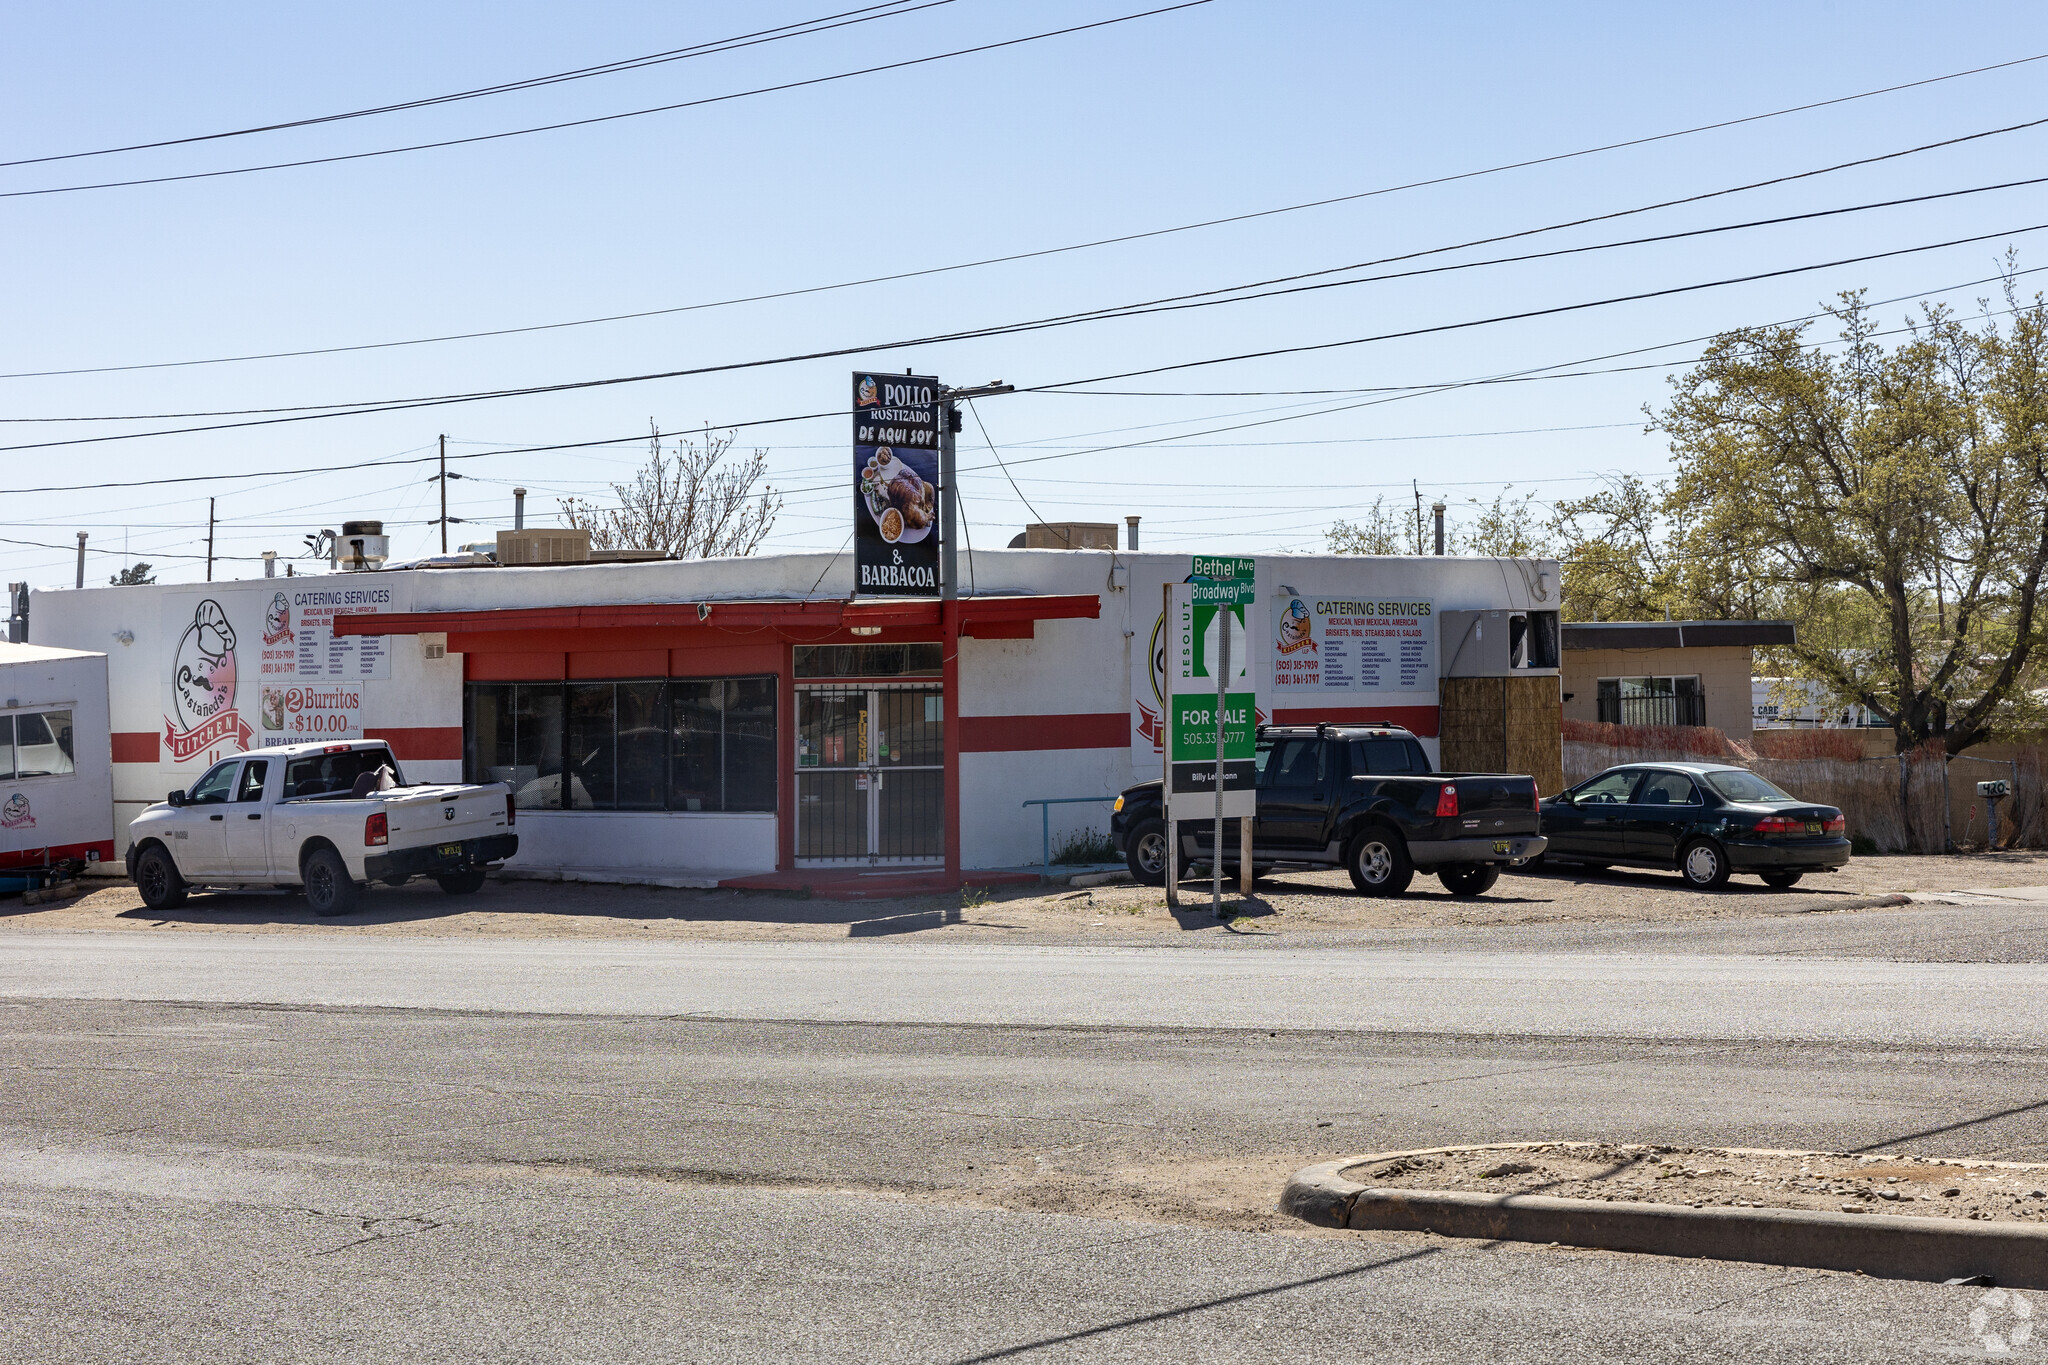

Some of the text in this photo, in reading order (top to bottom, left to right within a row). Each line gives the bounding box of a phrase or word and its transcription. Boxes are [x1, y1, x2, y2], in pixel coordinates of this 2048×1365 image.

[885, 384, 931, 408] POLLO
[871, 408, 930, 423] ROSTIZADO
[859, 426, 934, 445] DE AQUI SOY
[892, 549, 904, 565] &
[1194, 558, 1254, 576] Bethel Ave
[861, 564, 936, 587] BARBACOA
[295, 590, 390, 606] CATERING SERVICES
[1192, 582, 1254, 603] Broadway Blvd
[303, 608, 323, 616] MEXICAN,
[1316, 601, 1431, 616] CATERING SERVICES
[1328, 618, 1352, 626] MEXICAN,
[1325, 629, 1350, 637] BRISKETS,
[1351, 629, 1363, 637] RIBS,
[1276, 659, 1292, 671] (505)
[1275, 674, 1292, 686] (505)
[177, 665, 228, 716] Castañeda's
[288, 687, 359, 710] 2 Burritos
[1182, 710, 1210, 725] FOR
[1758, 706, 1779, 715] CARE
[295, 713, 347, 734] $10.00
[178, 716, 232, 754] KITCHEN
[858, 710, 868, 762] PUSH
[1192, 773, 1206, 782] Billy
